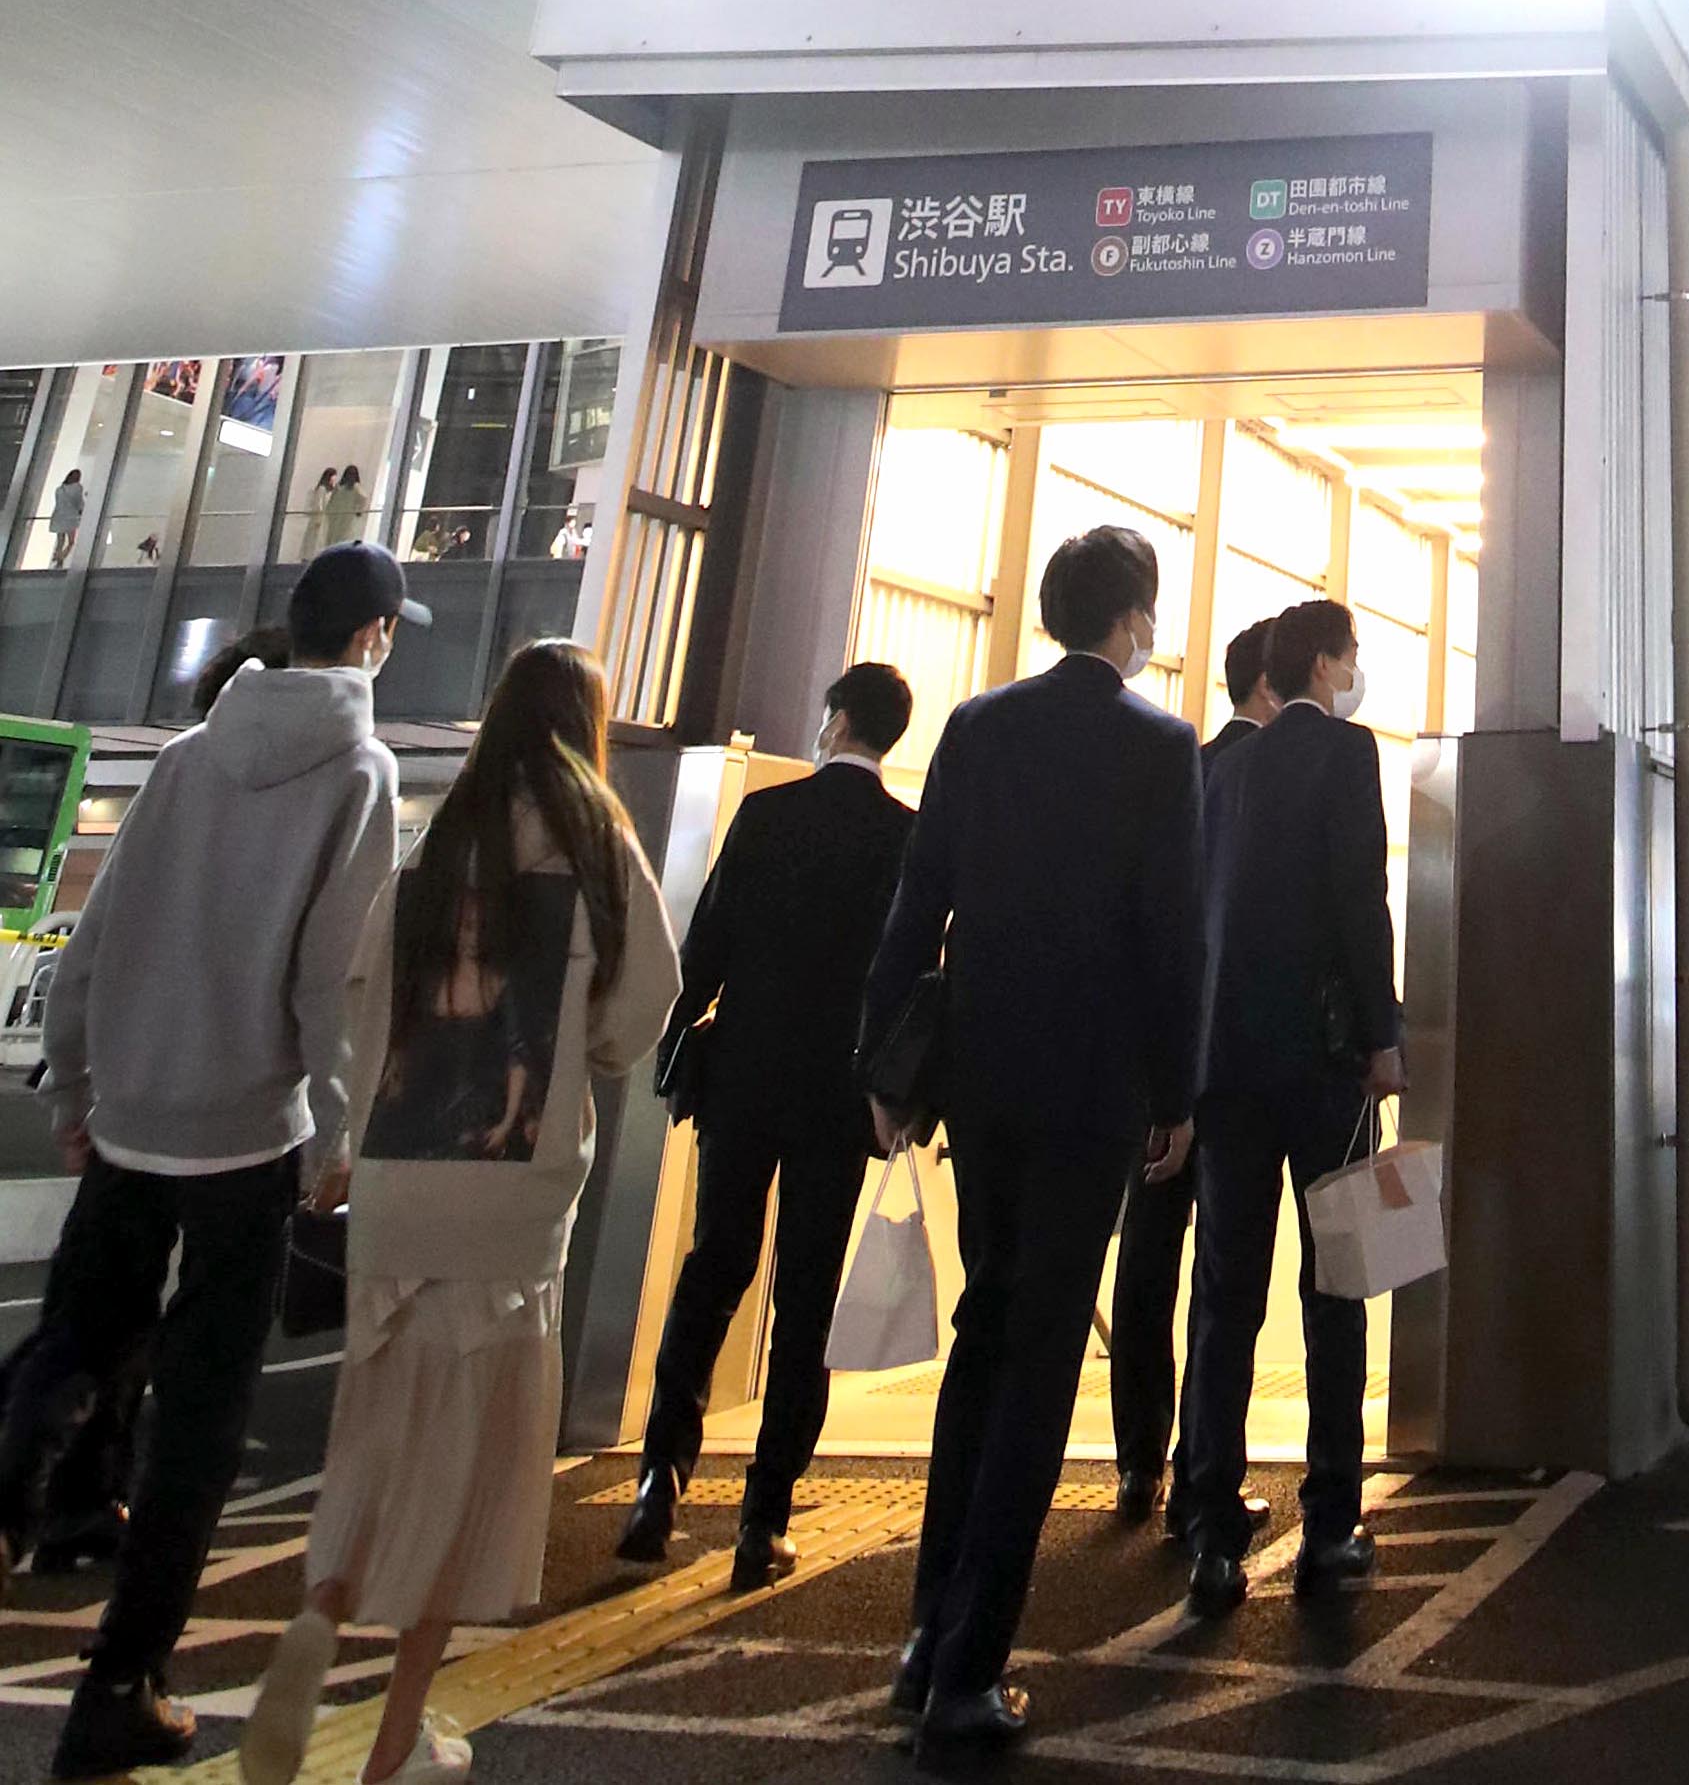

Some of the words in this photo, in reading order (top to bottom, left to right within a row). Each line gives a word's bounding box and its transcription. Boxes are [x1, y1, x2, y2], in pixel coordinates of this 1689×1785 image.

[1136, 184, 1195, 205] 東横線
[1256, 190, 1280, 208] DT
[1102, 197, 1128, 216] TY
[1136, 206, 1185, 224] Toyoko
[1189, 205, 1216, 221] Line
[1288, 197, 1377, 216] Den-en-toshi
[1381, 195, 1410, 211] Line
[896, 193, 1027, 242] 渋谷駅
[1131, 233, 1209, 256] 副都心線
[1287, 225, 1367, 248] 半蔵門線
[1104, 249, 1115, 265] F
[1259, 242, 1271, 256] Z
[1287, 248, 1363, 266] Hanzomon
[1366, 246, 1396, 262] Line
[894, 250, 1011, 285] Shibuya
[1020, 245, 1075, 274] Sta.
[1130, 255, 1205, 272] Fukutoshin
[1208, 253, 1237, 269] Line
